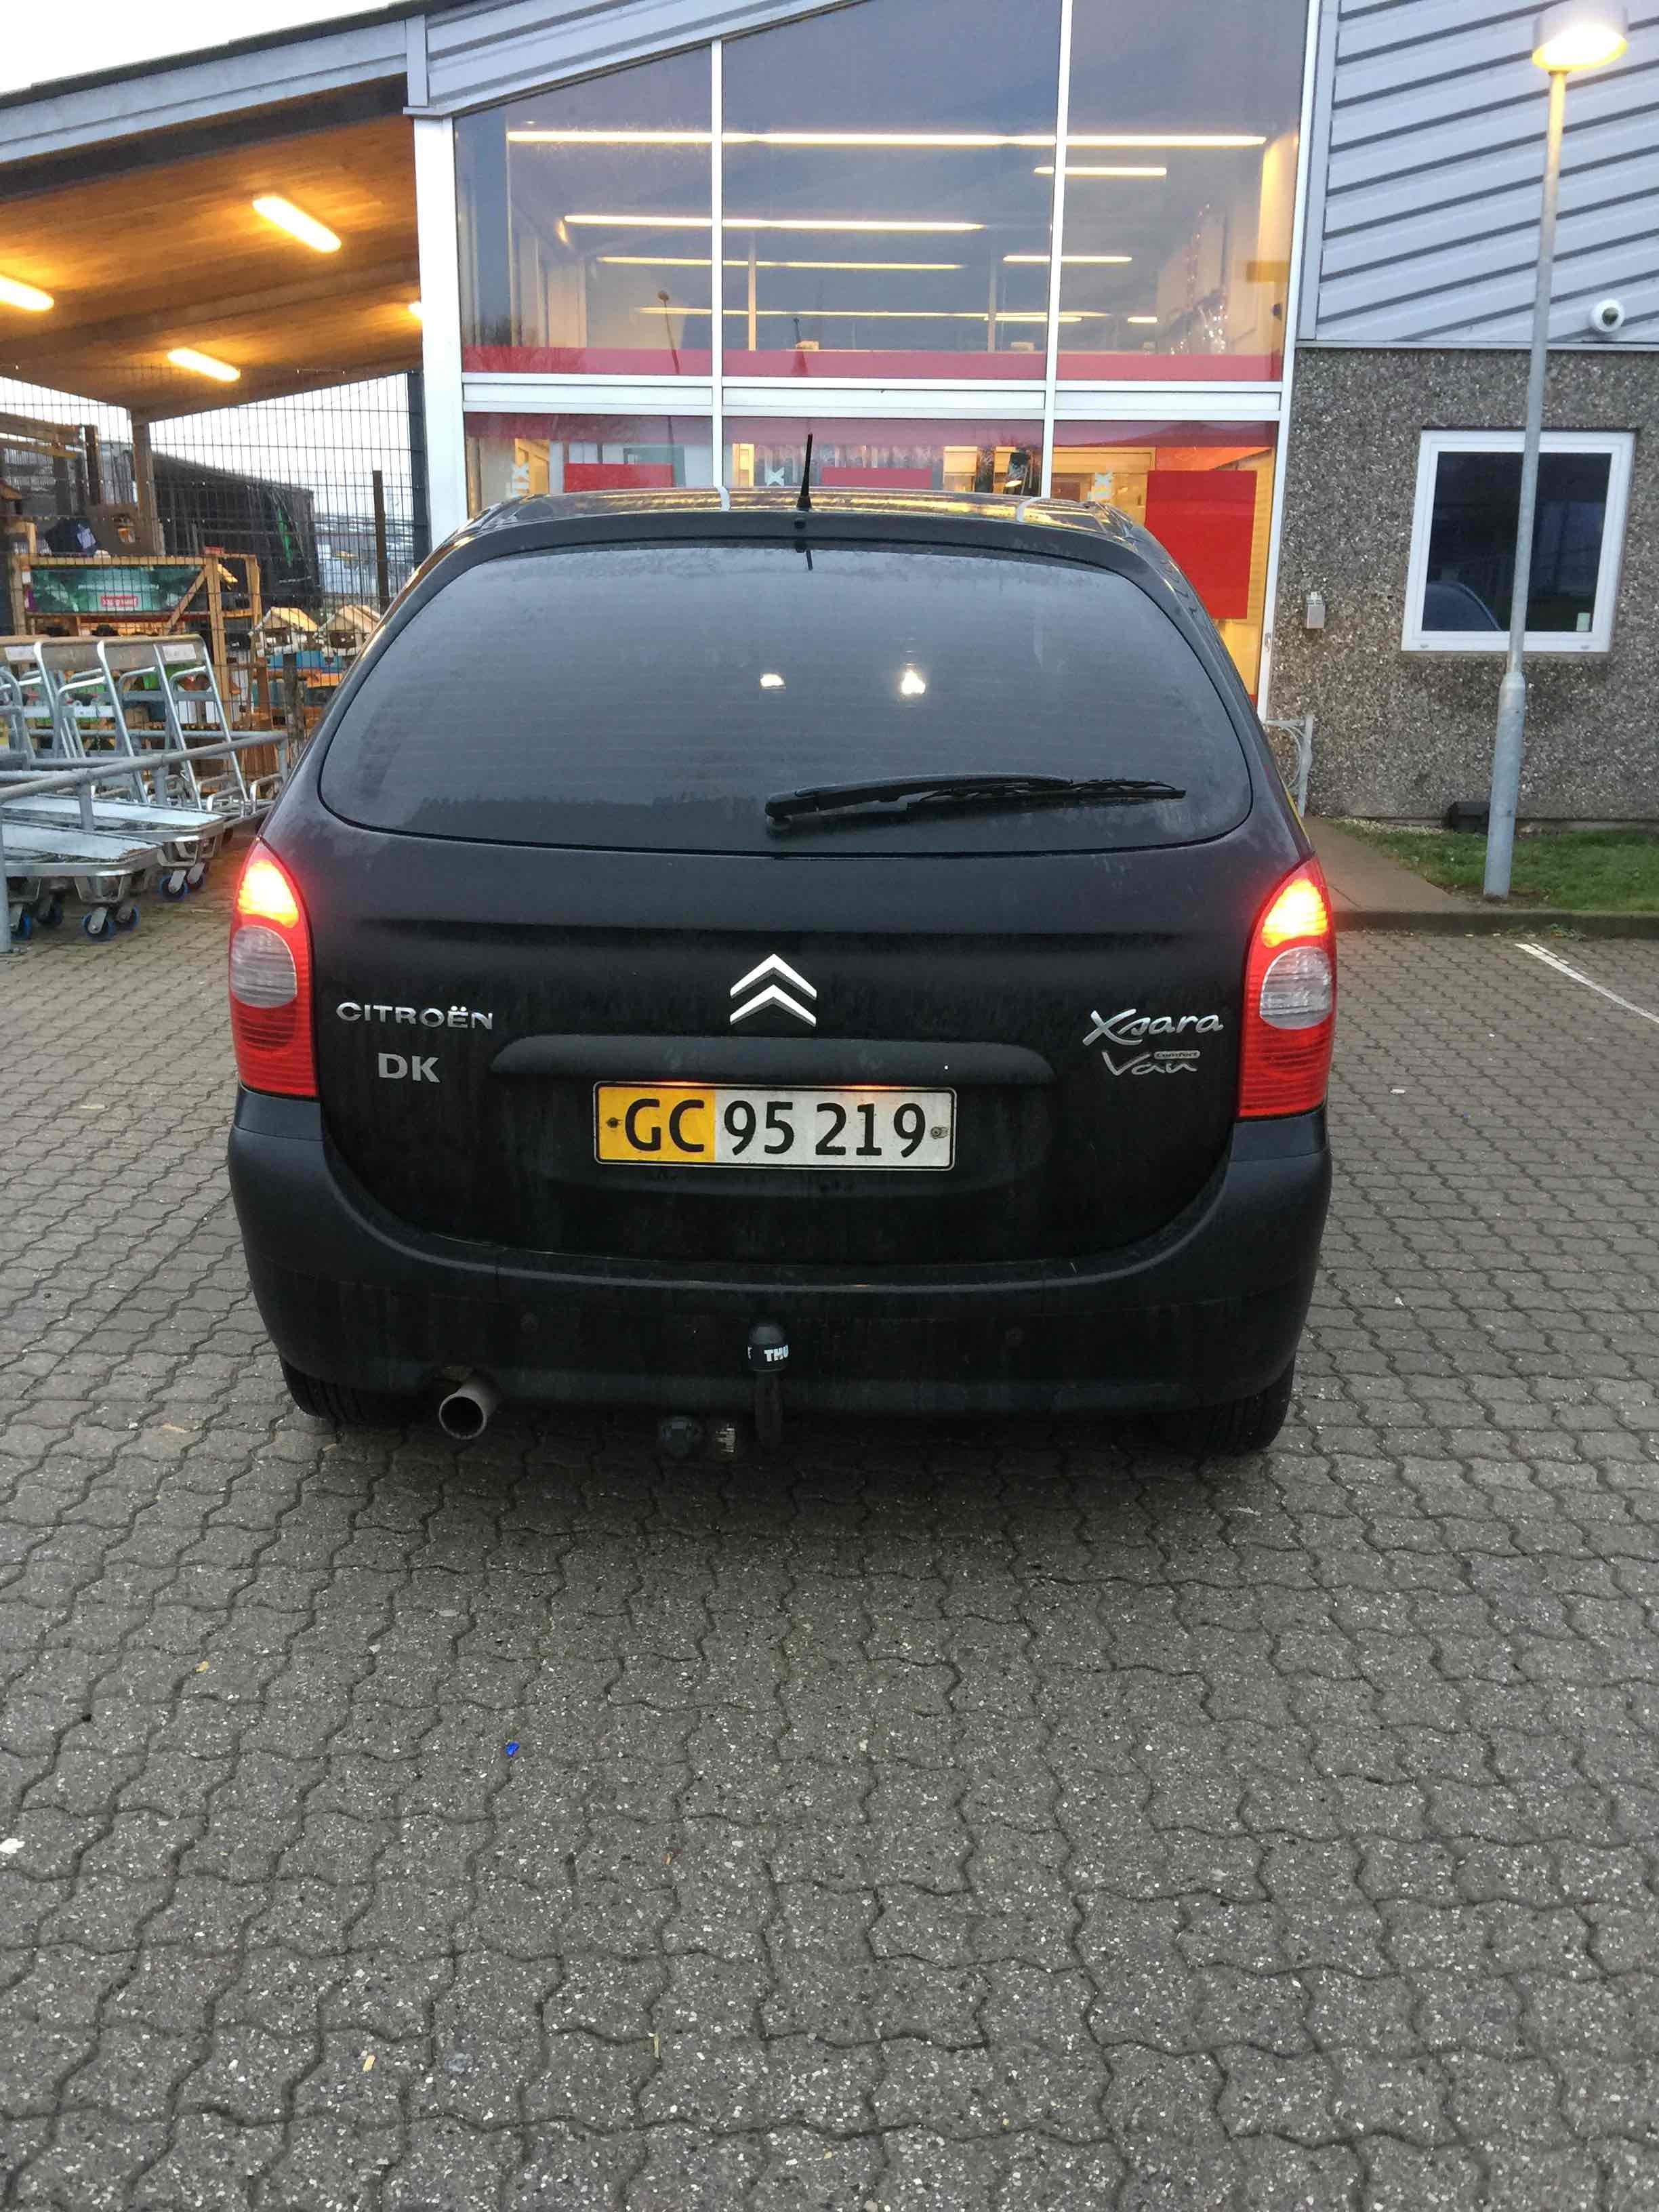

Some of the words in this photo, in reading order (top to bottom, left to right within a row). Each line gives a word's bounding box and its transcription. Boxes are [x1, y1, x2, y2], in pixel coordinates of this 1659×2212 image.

[336, 1002, 493, 1029] CITROËN
[1083, 1008, 1224, 1046] Xsara
[377, 1052, 440, 1083] DK
[1101, 1051, 1197, 1076] Van
[625, 1099, 705, 1152] GC
[724, 1100, 794, 1155] 95
[815, 1103, 926, 1158] 219
